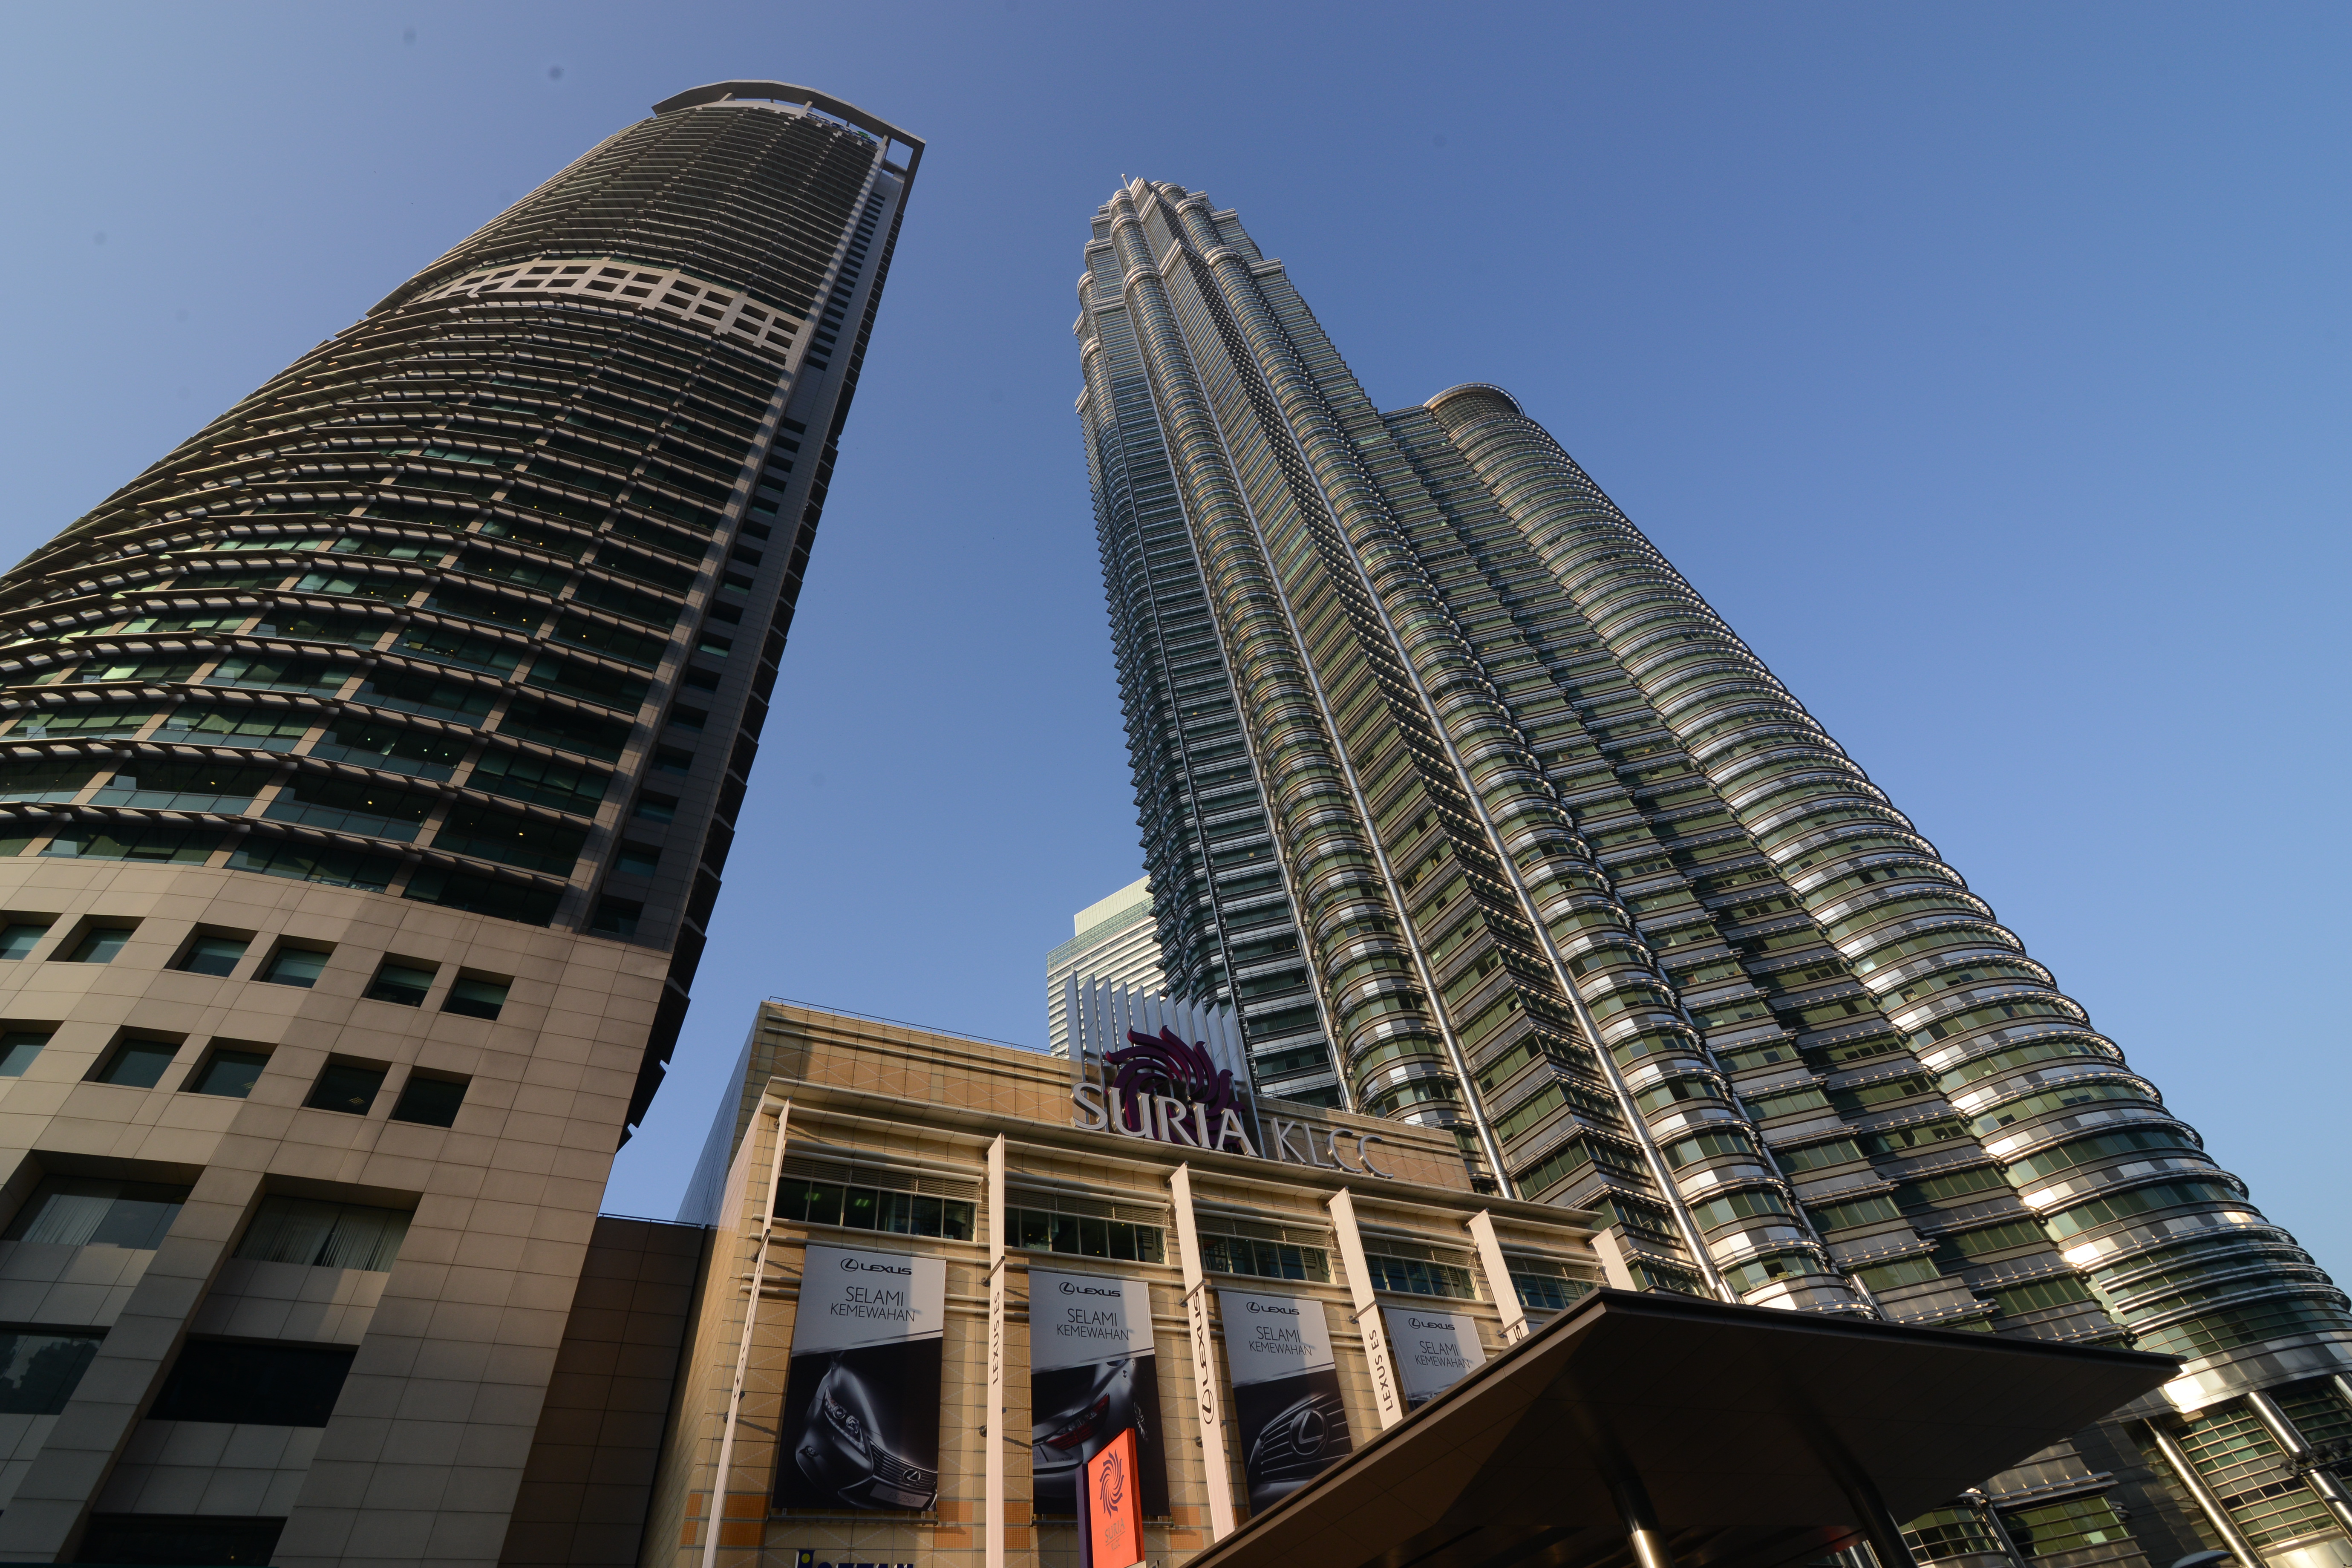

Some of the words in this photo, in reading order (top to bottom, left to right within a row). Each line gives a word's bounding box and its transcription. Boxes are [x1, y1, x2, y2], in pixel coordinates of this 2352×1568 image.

[1070, 1081, 1260, 1157] SURIA
[1271, 1117, 1394, 1179] KLCC
[860, 1263, 912, 1275] LEXUS
[845, 1286, 904, 1307] SELAMI
[1076, 1286, 1121, 1297] LEXUS
[994, 1291, 1000, 1316] ES
[1261, 1305, 1300, 1315] LEXUS
[830, 1303, 915, 1322] KEMEWAHAN
[1067, 1308, 1117, 1327] SELAMI
[1057, 1323, 1129, 1341] KEMEWAHAN
[1421, 1321, 1455, 1330] LEXUS
[1193, 1291, 1208, 1387] LEXUS
[1256, 1326, 1300, 1343] SELAMI
[1369, 1329, 1379, 1351] ES
[1249, 1340, 1312, 1356] KEMEWAHAN
[1419, 1340, 1459, 1356] SELAMI
[1415, 1355, 1470, 1369] KEMEWAHAN
[1375, 1354, 1393, 1412] LEXUS
[899, 1495, 916, 1504] 250
[1105, 1518, 1125, 1543] SURIA
[1111, 1538, 1121, 1551] KLCC
